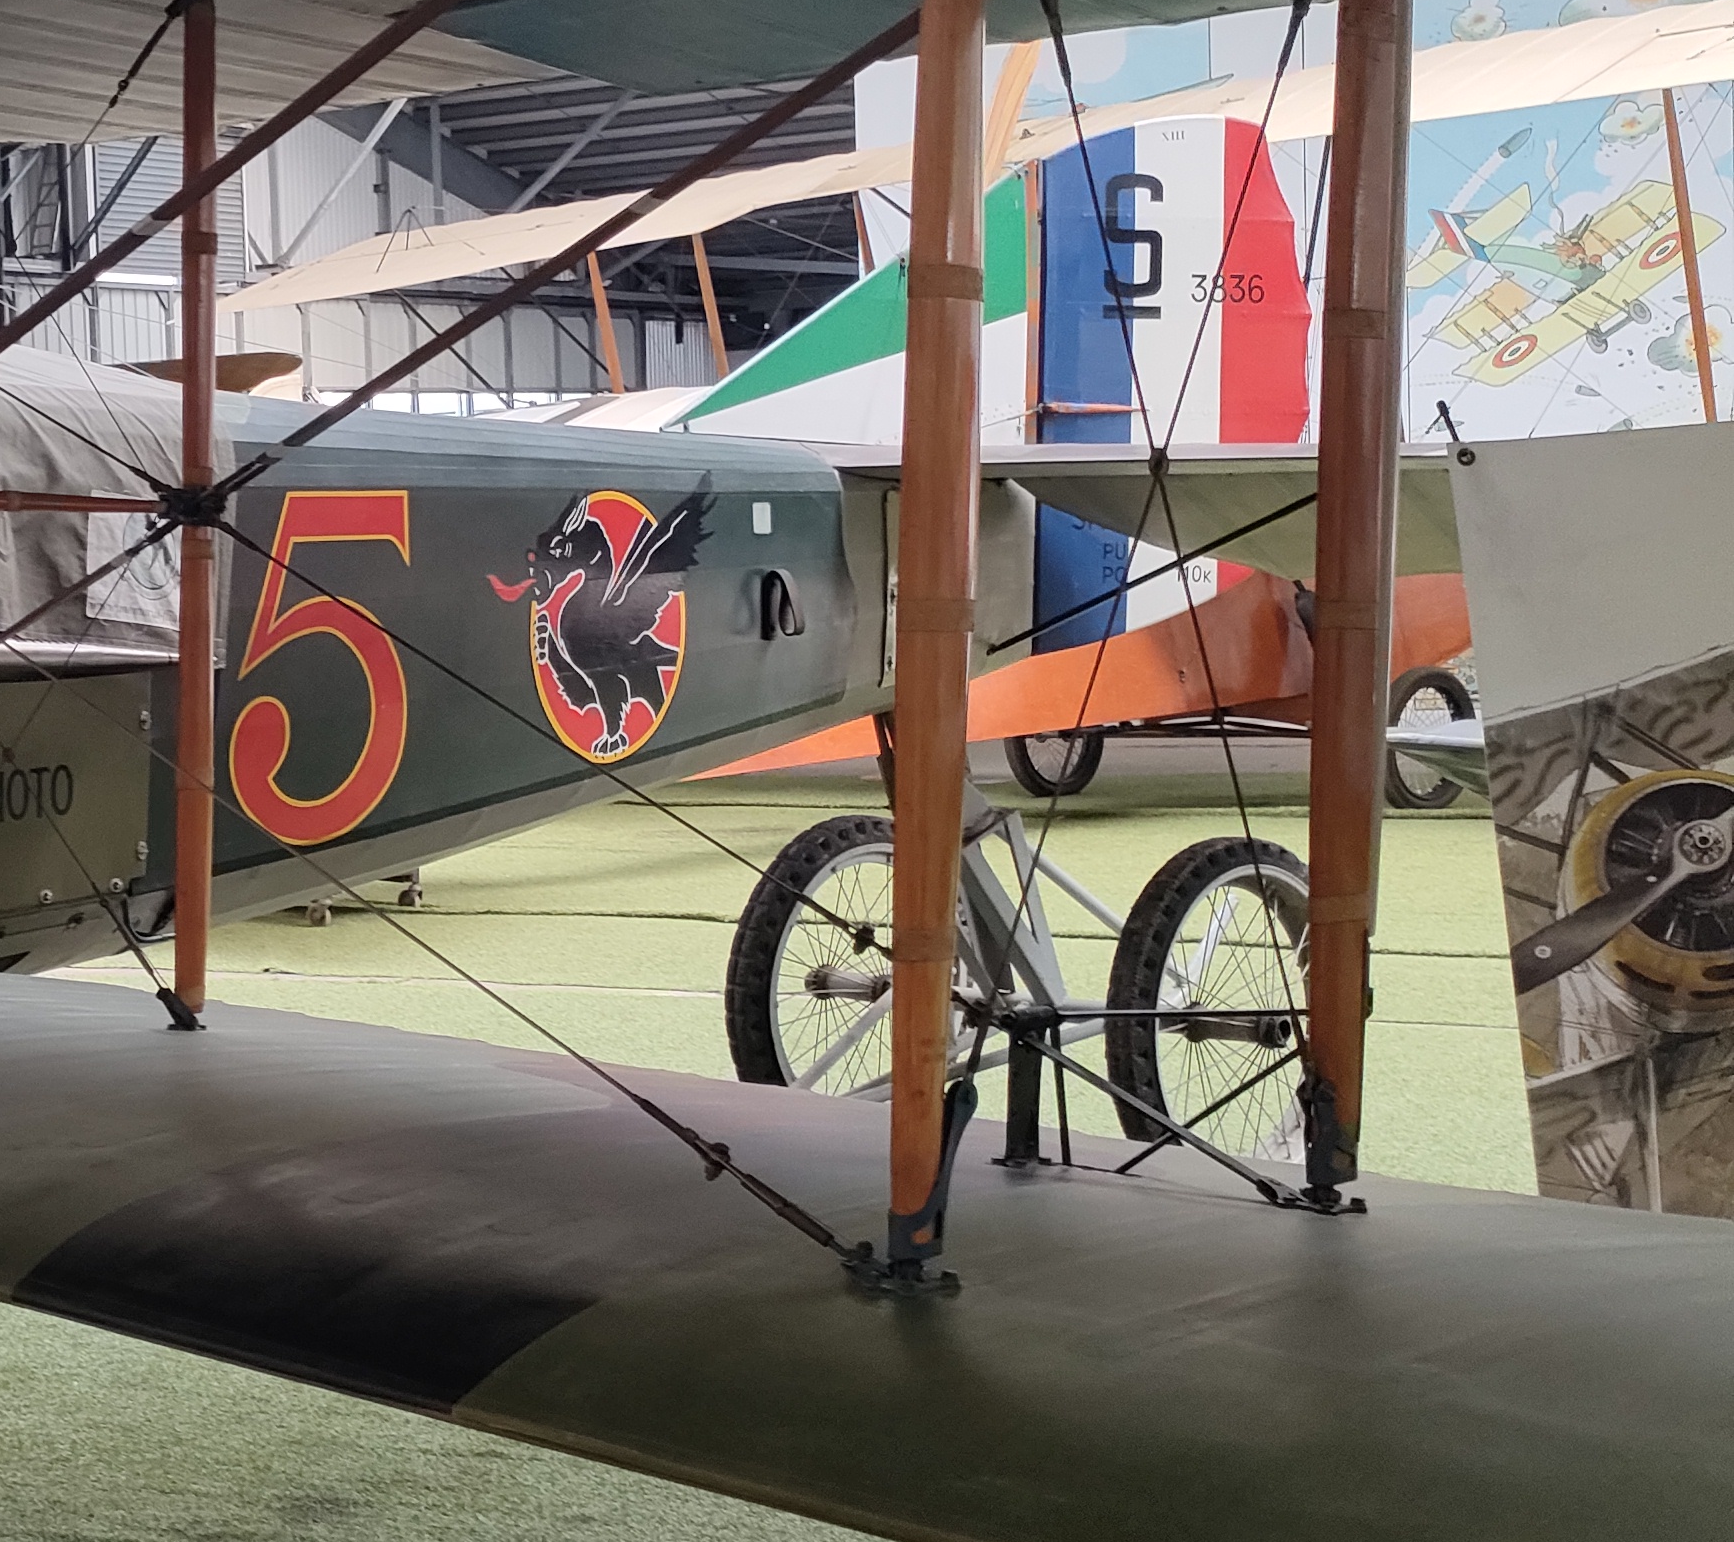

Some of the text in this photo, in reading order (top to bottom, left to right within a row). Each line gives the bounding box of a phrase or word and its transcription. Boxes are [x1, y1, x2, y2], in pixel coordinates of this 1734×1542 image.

[1162, 130, 1186, 142] XIII
[1104, 173, 1164, 298] S
[1190, 274, 1265, 303] 3836
[229, 489, 411, 847] 5
